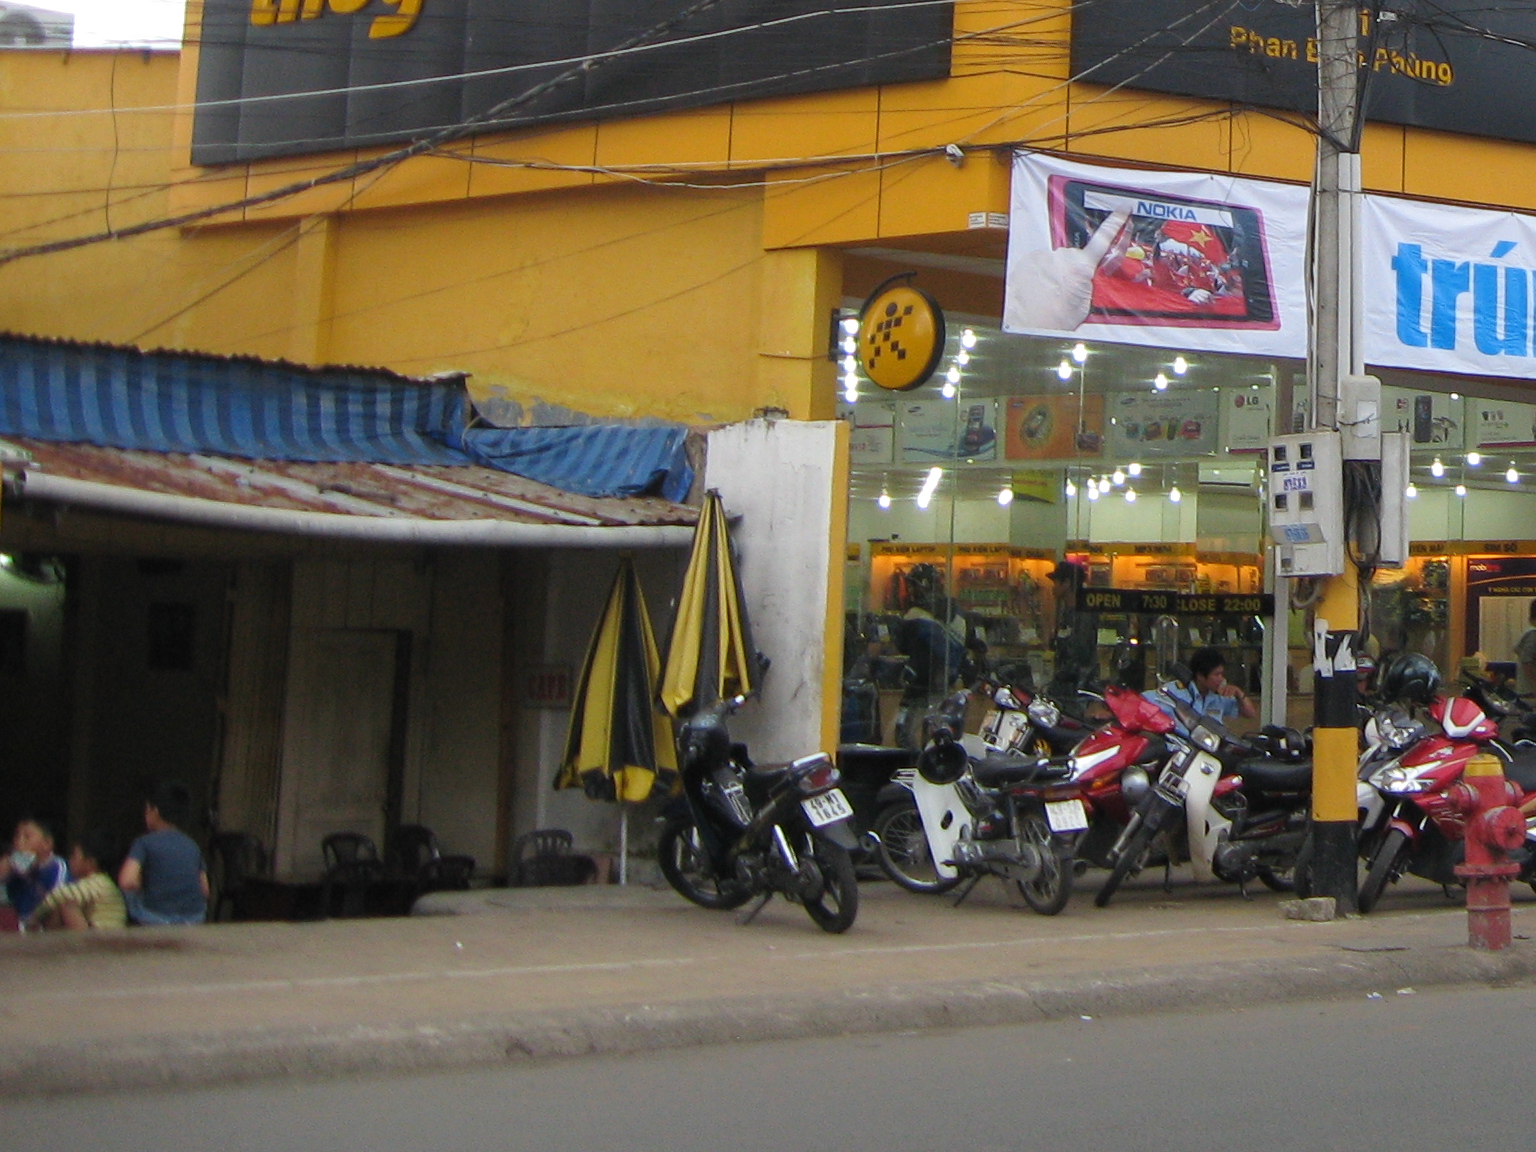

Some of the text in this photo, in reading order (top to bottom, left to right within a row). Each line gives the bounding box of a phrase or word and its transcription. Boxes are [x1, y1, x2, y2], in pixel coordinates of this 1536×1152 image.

[1137, 201, 1197, 222] NOKIA
[1246, 397, 1259, 406] LG
[1086, 595, 1122, 609] OPEN
[1142, 594, 1168, 609] 7:30
[1224, 598, 1261, 612] 22:00
